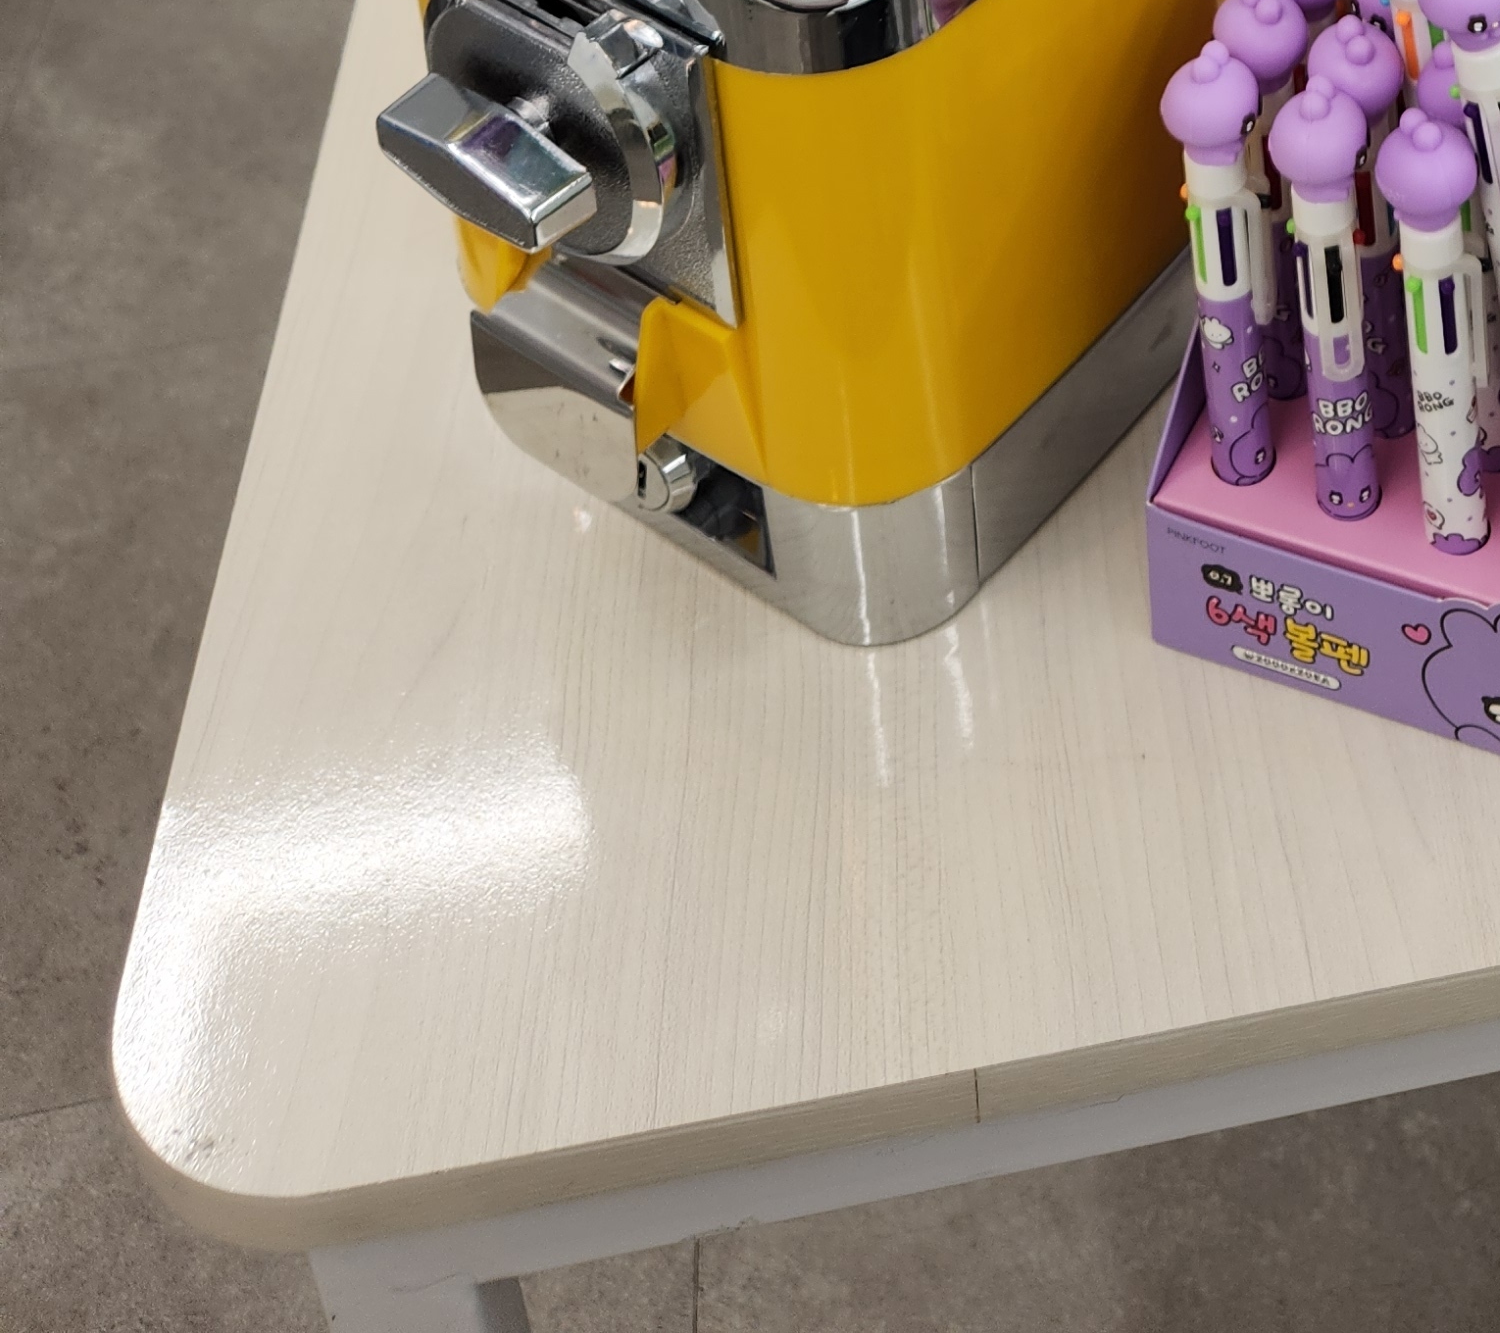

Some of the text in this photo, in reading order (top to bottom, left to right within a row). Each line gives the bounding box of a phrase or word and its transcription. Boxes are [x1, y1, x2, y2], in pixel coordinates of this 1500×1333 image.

[1317, 391, 1369, 419] BBO
[1417, 390, 1442, 402] BBO
[1167, 526, 1226, 554] PINKFOOT
[1249, 574, 1335, 621] 뽀롱이
[1206, 595, 1371, 676] 6색 볼펜
